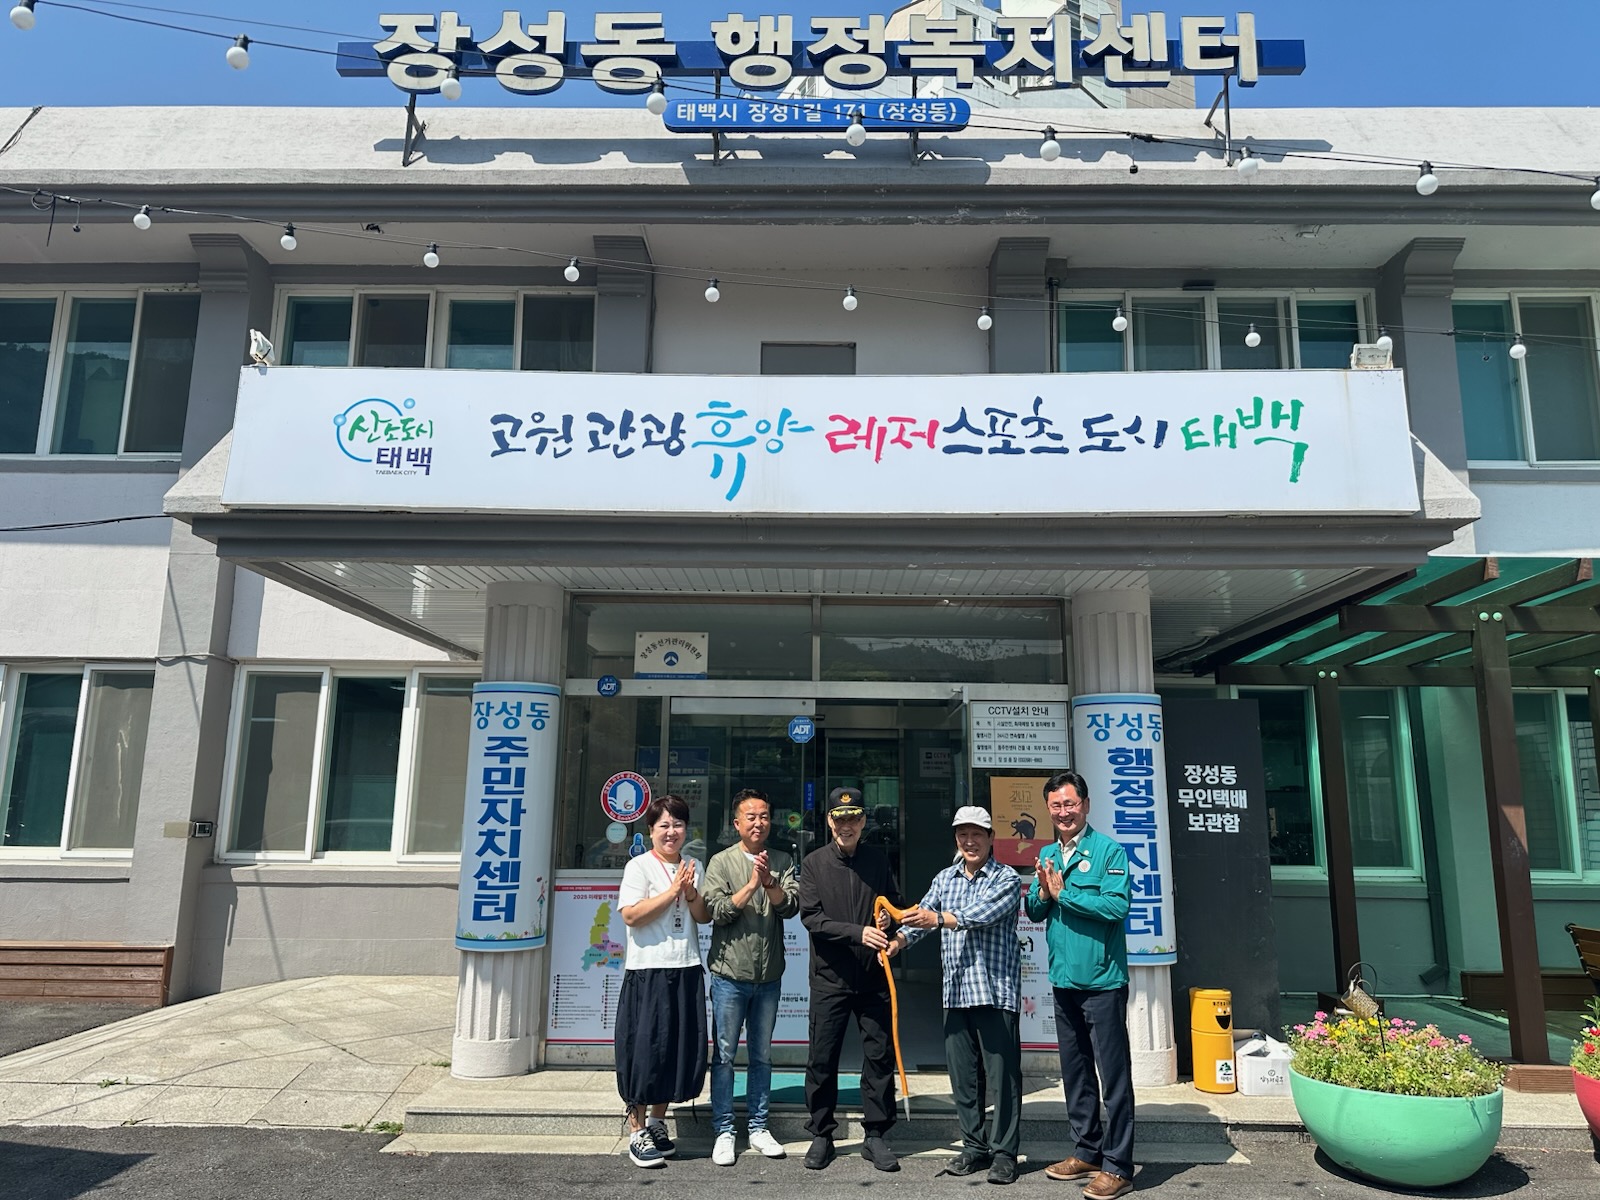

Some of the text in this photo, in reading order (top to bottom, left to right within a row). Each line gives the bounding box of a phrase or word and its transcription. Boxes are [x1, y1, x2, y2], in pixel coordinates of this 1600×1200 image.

[372, 11, 1259, 95] 장성동 행정복지센터
[677, 103, 957, 122] 태백시 장성1길 171 (장성동)
[348, 410, 433, 443] 산소도시
[1079, 413, 1169, 454] 도시
[1179, 396, 1309, 484] 태백
[376, 446, 433, 476] 태백
[601, 683, 616, 691] ADT
[473, 701, 550, 731] 장성동
[988, 706, 1049, 716] CCTV설치 안내
[793, 725, 810, 735] ADT
[1086, 712, 1163, 743] 장성동
[1184, 764, 1238, 785] 장성동
[1178, 789, 1248, 809] 무인택배
[472, 736, 529, 923] 주민자치센터
[1188, 812, 1241, 833] 보관함
[1107, 747, 1163, 937] 행정복지센터
